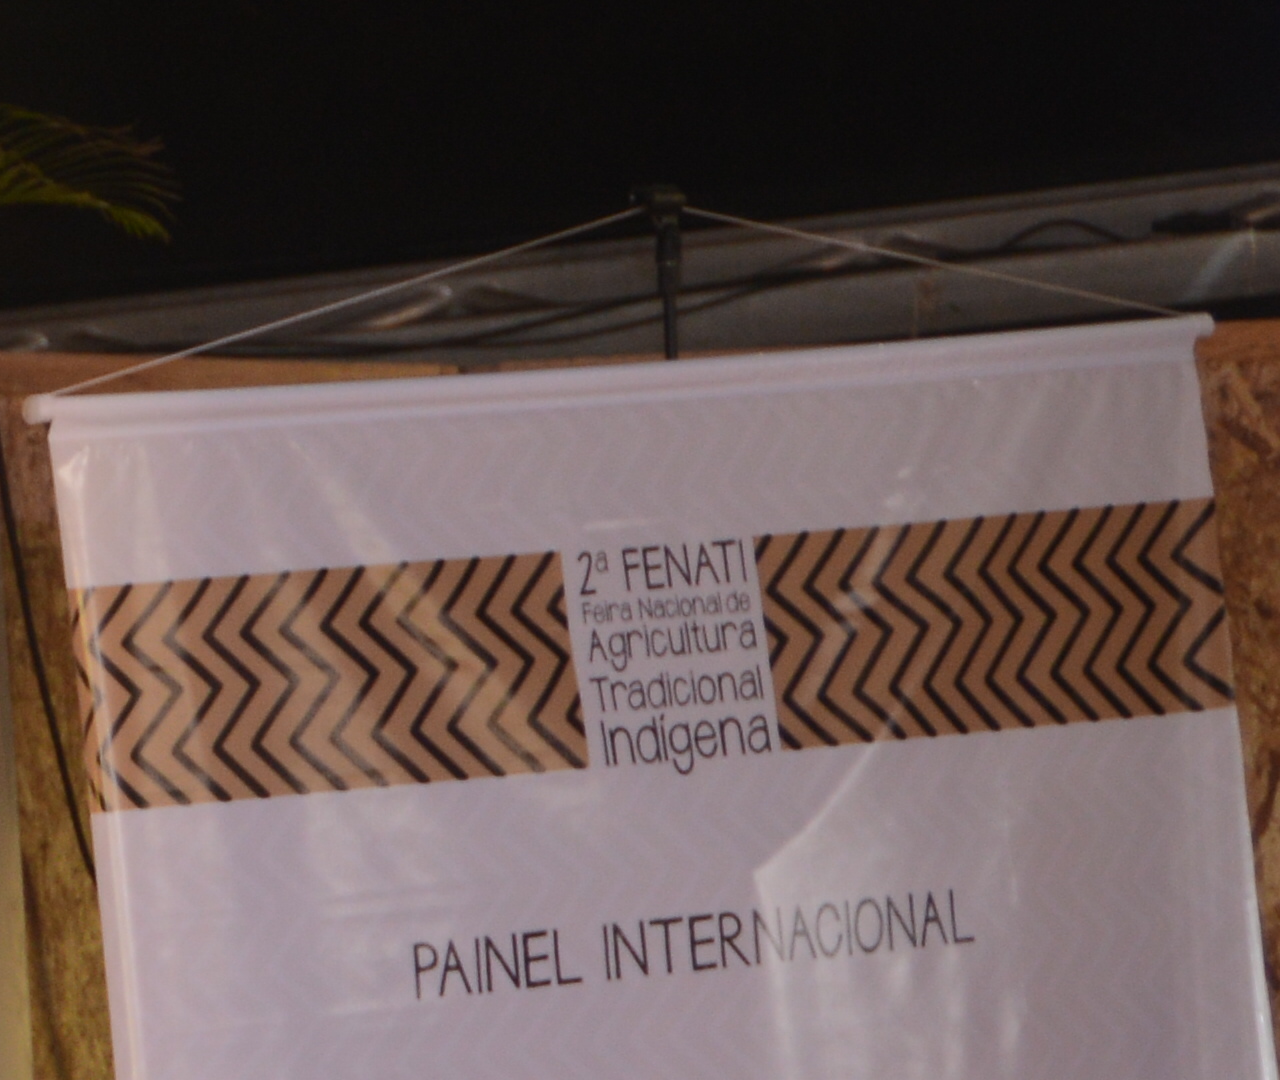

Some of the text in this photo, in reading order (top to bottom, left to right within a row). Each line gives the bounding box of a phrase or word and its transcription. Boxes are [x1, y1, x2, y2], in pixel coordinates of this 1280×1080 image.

[622, 538, 748, 592] FENATI
[582, 590, 752, 625] Feira Nacional de
[589, 618, 758, 673] Agricultura
[590, 664, 765, 713] Tradicional
[600, 713, 773, 776] Indígena
[413, 888, 976, 1000] PAINEL INTERNACIONAL
